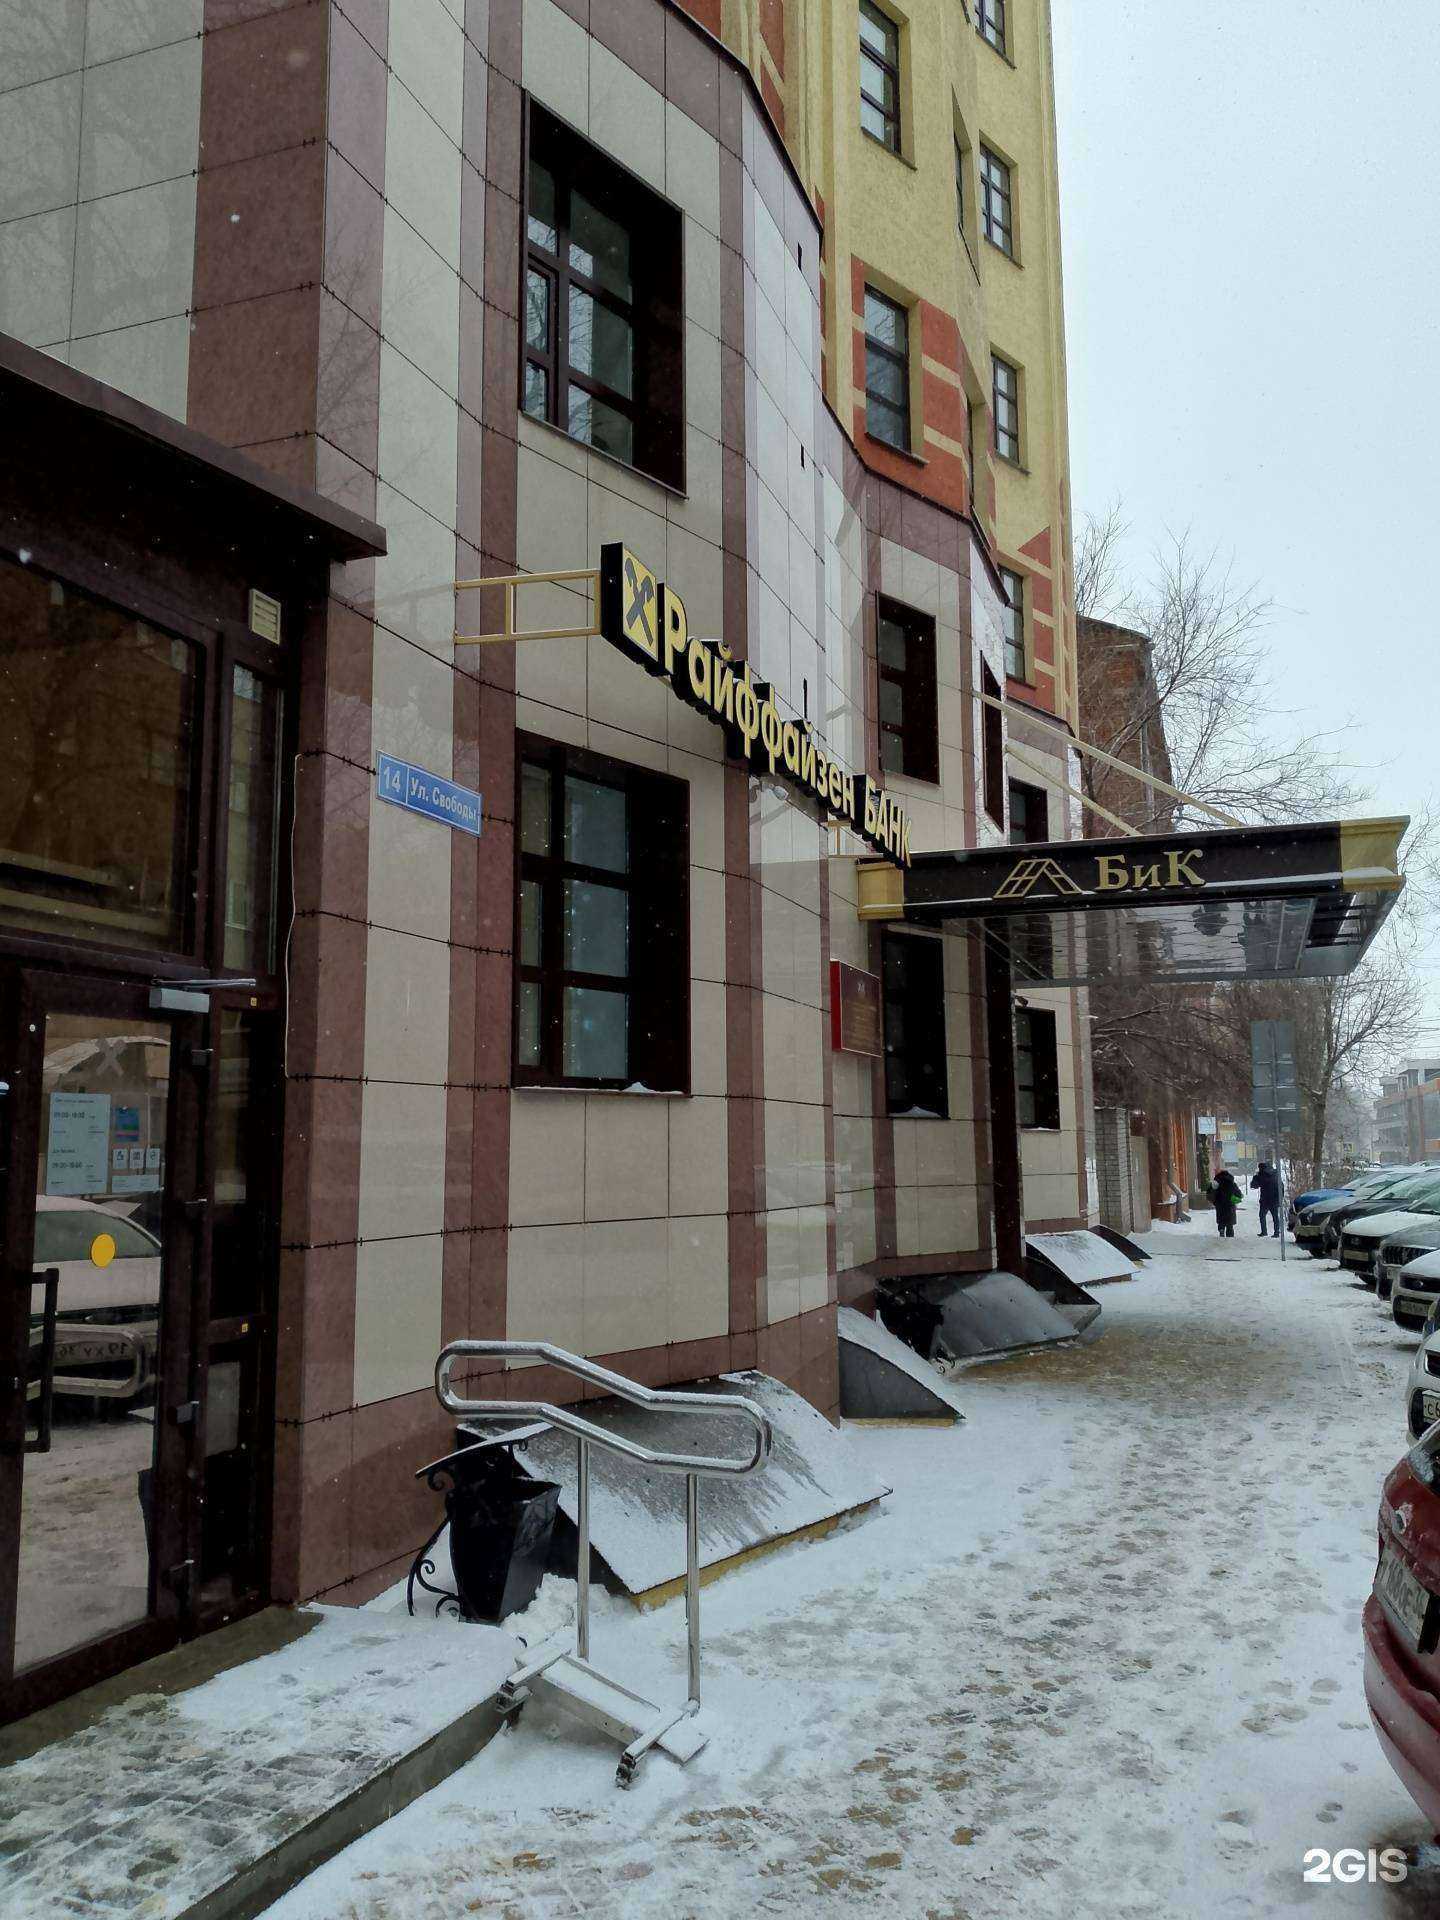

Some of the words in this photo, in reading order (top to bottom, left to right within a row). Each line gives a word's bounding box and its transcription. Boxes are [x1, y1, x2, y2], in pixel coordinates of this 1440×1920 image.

[657, 583, 856, 823] Райффайзен
[863, 774, 913, 869] БАНК
[383, 766, 401, 793] 14
[410, 776, 429, 802] Ул.
[432, 786, 477, 822] Свободы
[1094, 849, 1206, 890] БиК
